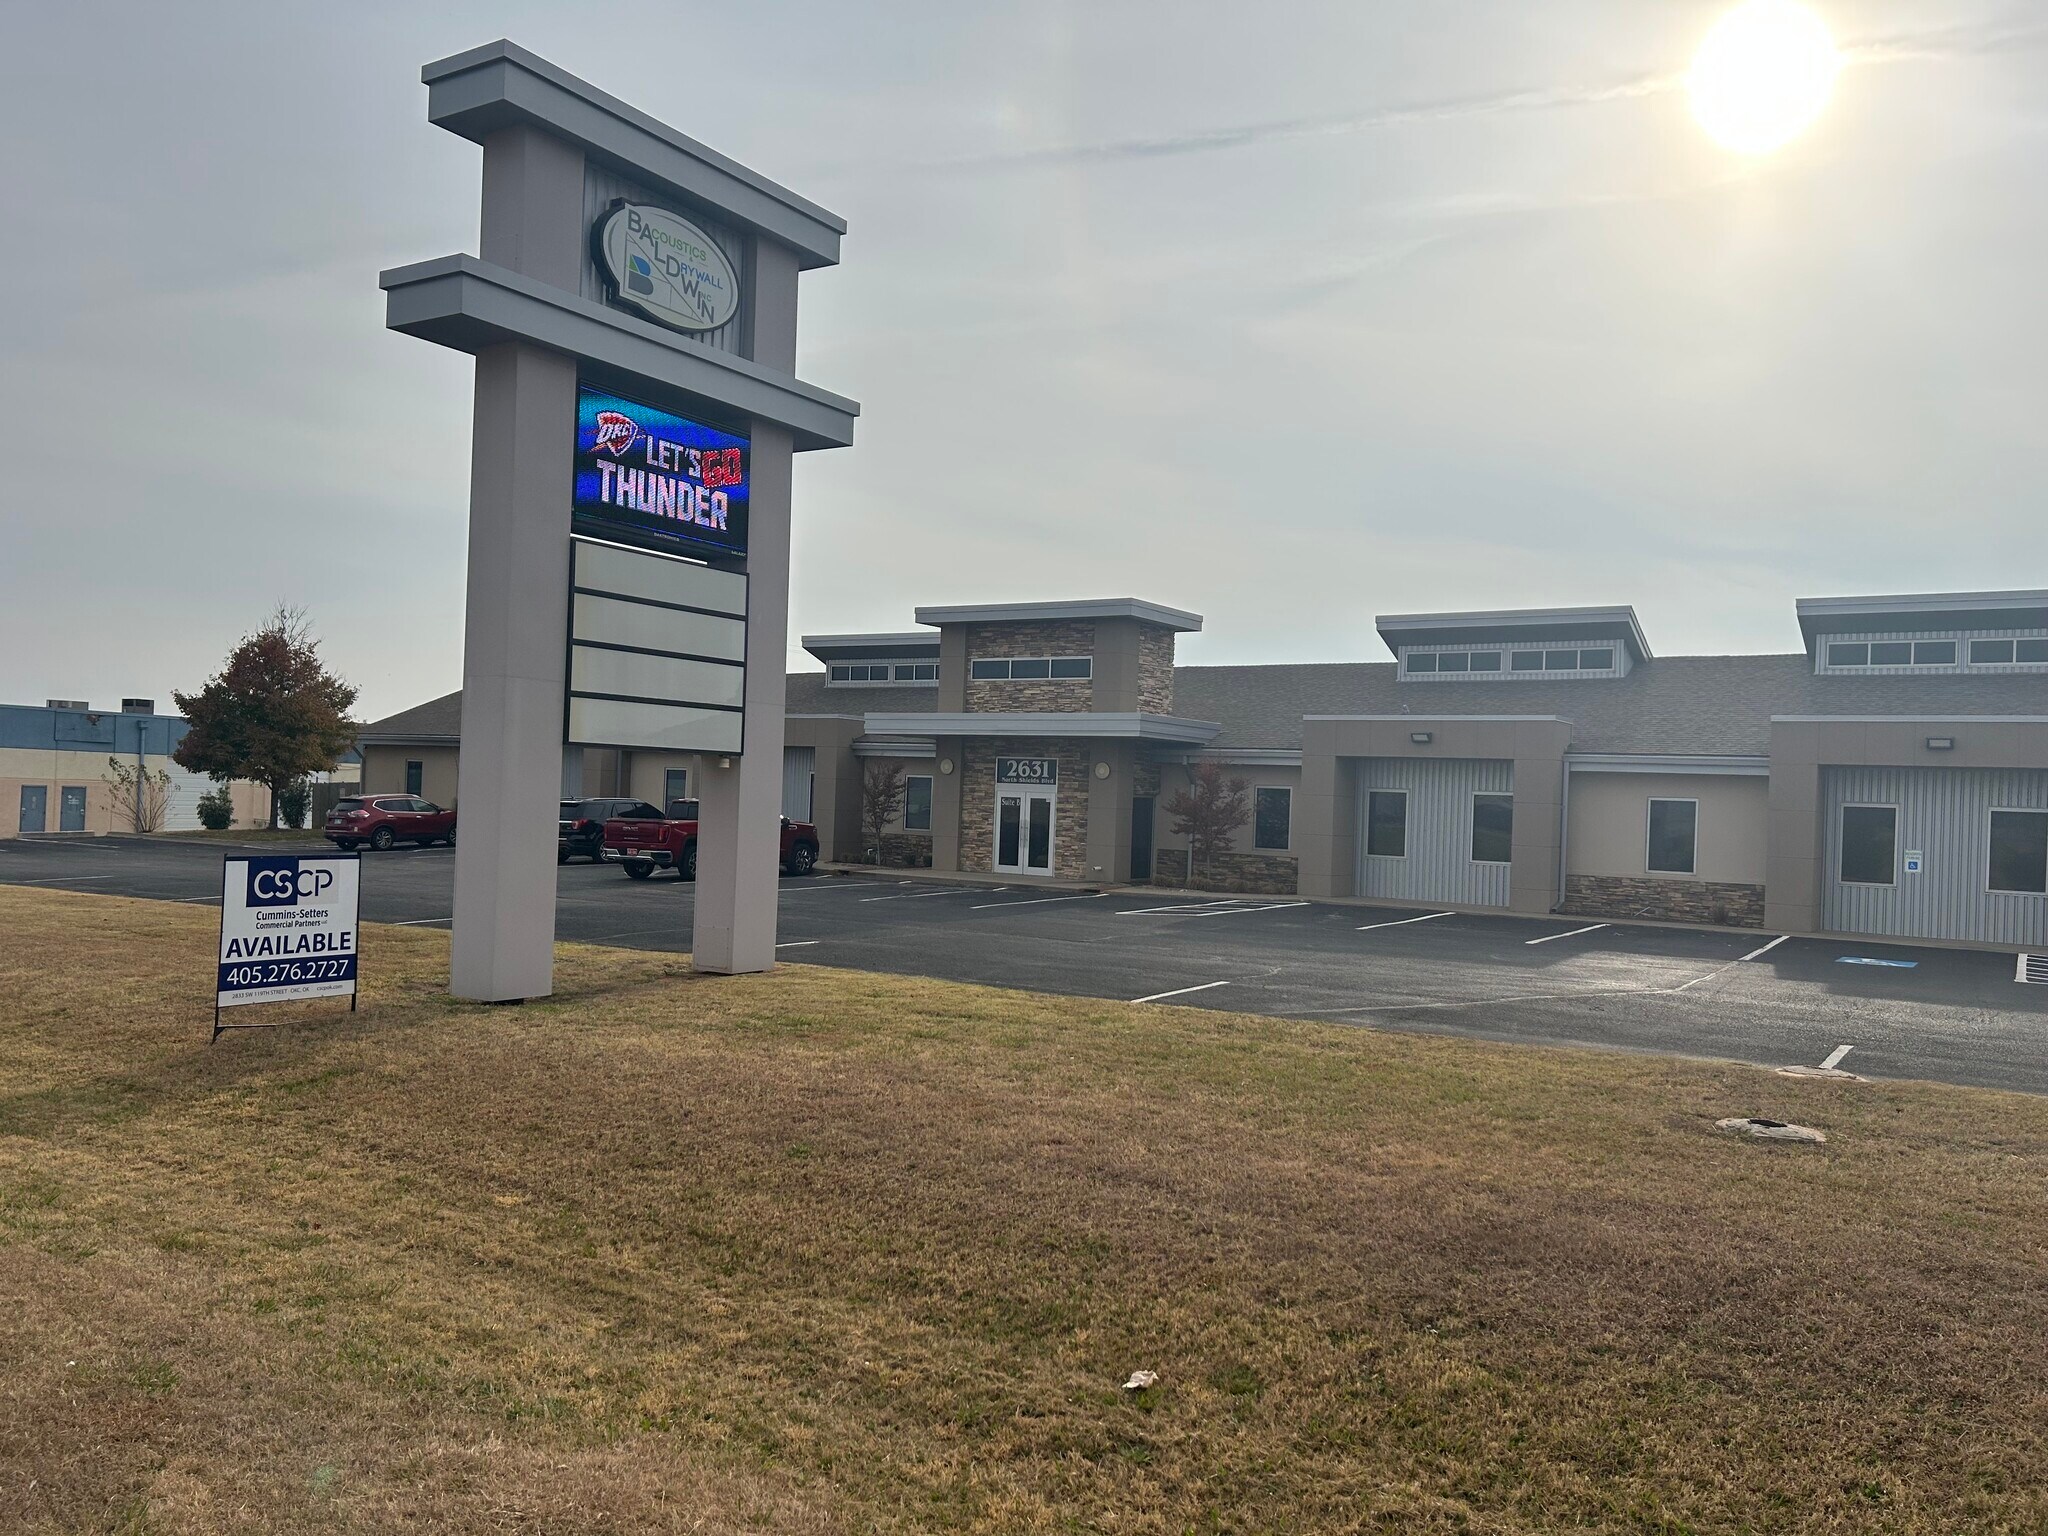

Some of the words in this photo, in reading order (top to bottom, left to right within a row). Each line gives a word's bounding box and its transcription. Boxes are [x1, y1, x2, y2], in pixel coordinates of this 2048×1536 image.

[627, 209, 714, 324] BALDWIN
[646, 435, 700, 478] LET'S
[702, 447, 742, 488] GO
[597, 458, 728, 531] THUNDER
[1007, 760, 1049, 778] 2631
[1001, 798, 1015, 806] Suite
[253, 869, 333, 899] CSCP
[255, 921, 294, 930] Commercial
[294, 919, 321, 928] Partners
[256, 909, 329, 921] Cummins-Setters
[225, 931, 351, 959] AVAILABLE
[226, 959, 349, 986] 405.276.2727
[254, 989, 270, 997] 119TH
[270, 988, 287, 996] STREET
